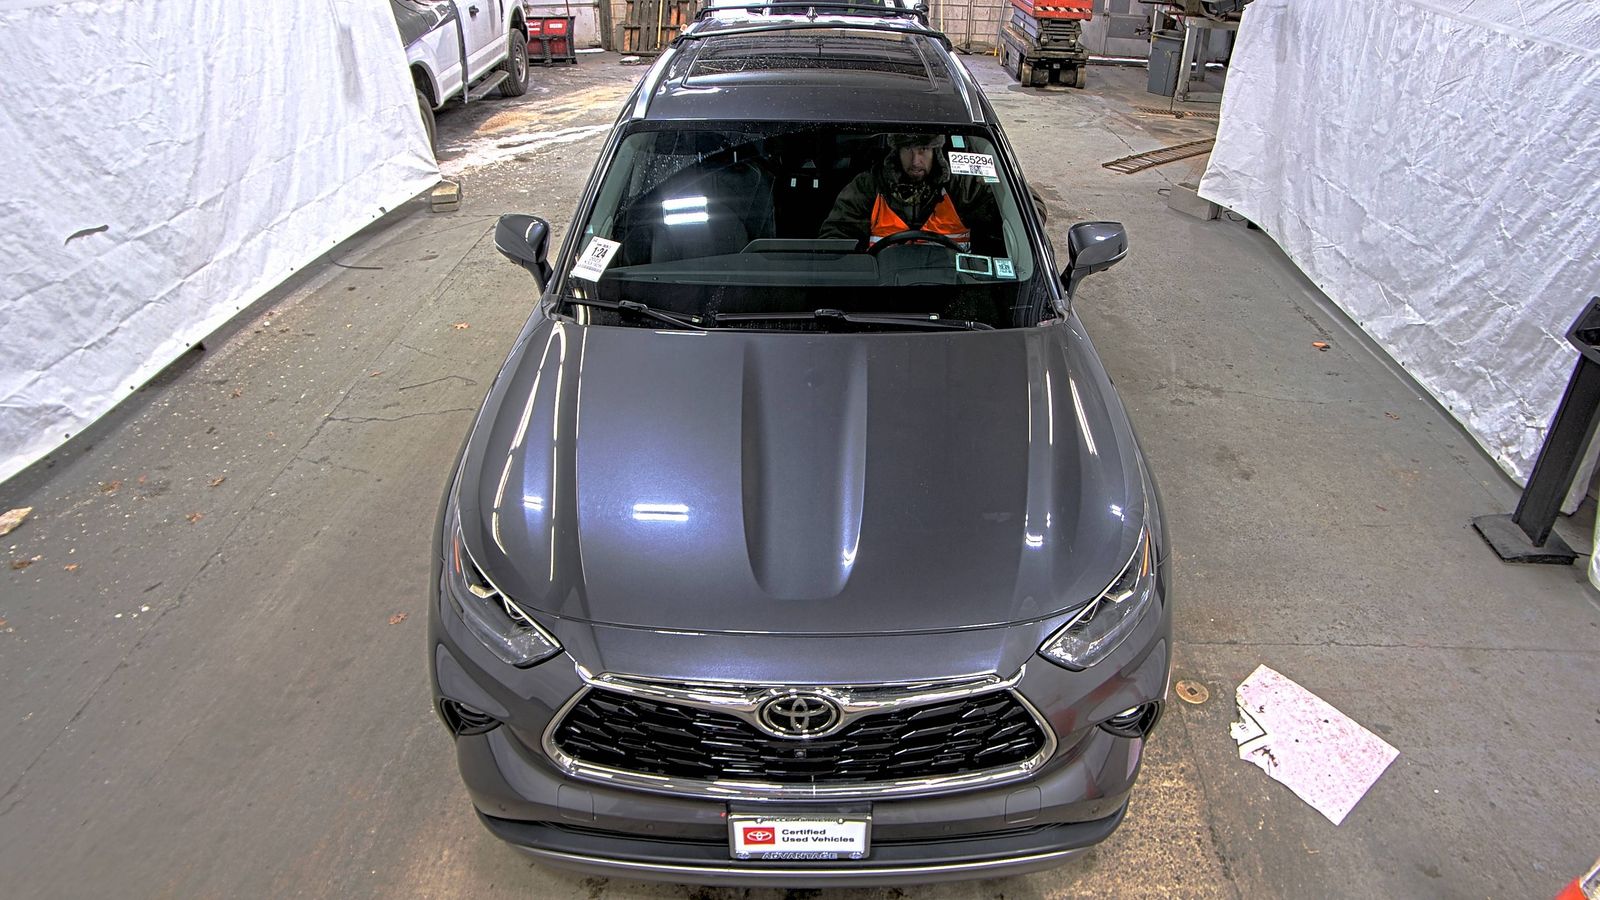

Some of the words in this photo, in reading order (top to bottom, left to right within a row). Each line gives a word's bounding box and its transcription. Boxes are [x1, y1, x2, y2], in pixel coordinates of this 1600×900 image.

[951, 154, 993, 165] 2255294
[591, 246, 609, 259] 1:24
[781, 828, 827, 836] Certified
[761, 852, 838, 860] ADVANTAGE
